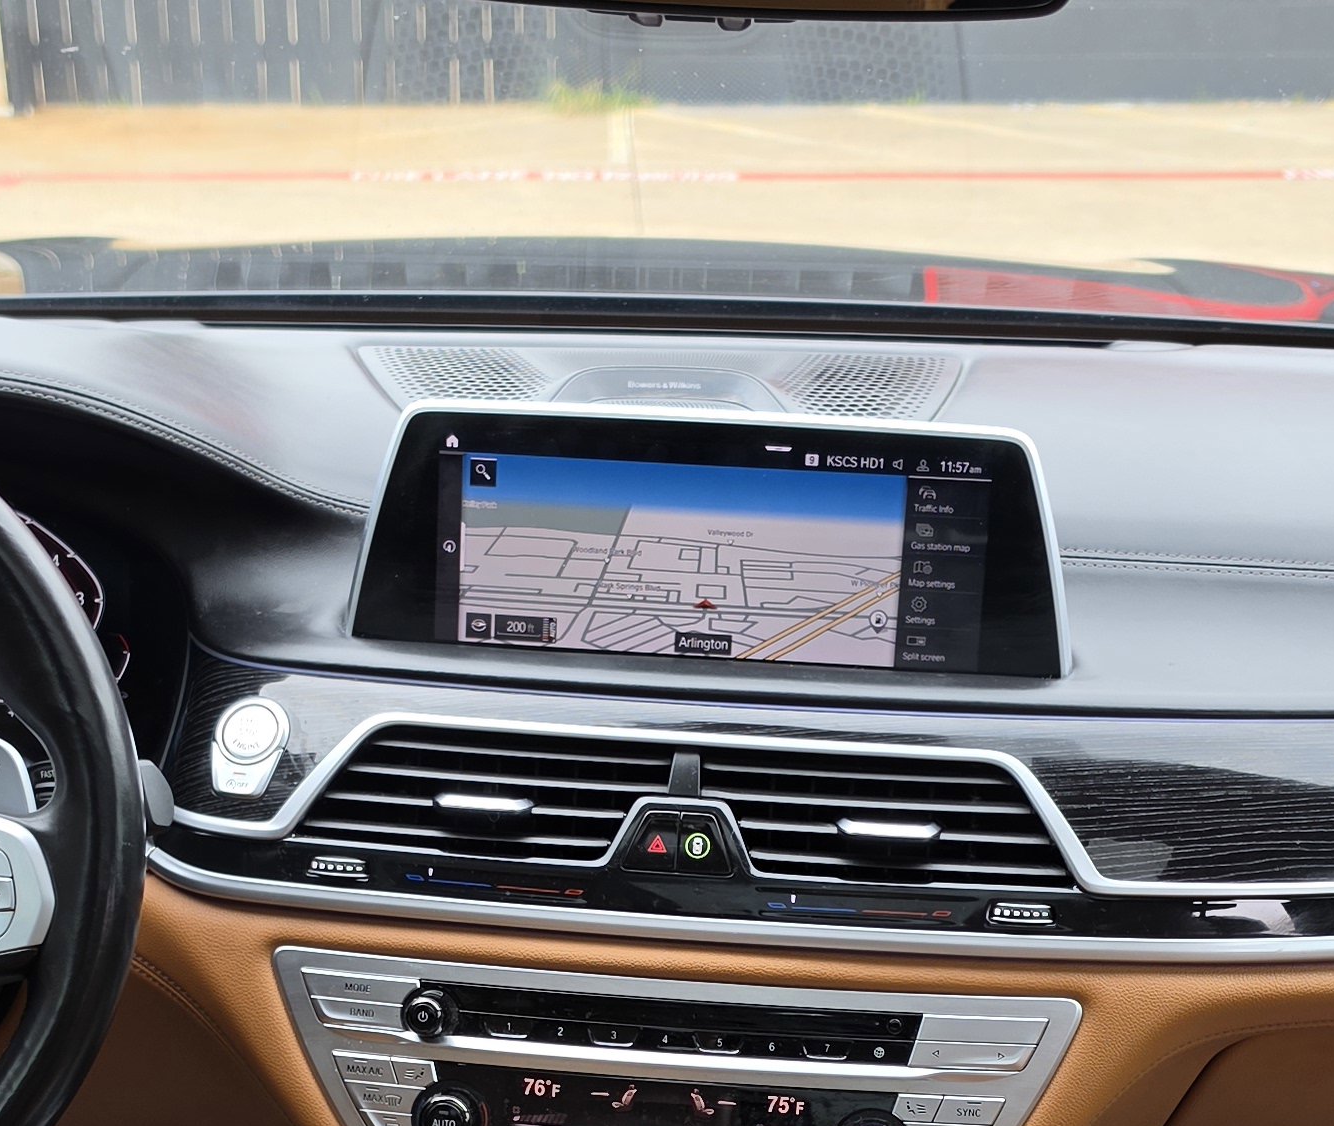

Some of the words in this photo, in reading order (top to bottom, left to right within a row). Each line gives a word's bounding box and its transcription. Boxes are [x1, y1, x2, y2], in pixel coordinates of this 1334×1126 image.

[826, 455, 858, 469] KSCS
[860, 457, 885, 470] HD1
[913, 503, 937, 513] Traffic
[938, 505, 955, 514] Info
[707, 529, 744, 538] Valleywood
[910, 541, 926, 551] Gas
[926, 541, 953, 552] station
[953, 544, 971, 553] map
[616, 583, 644, 592] Springs
[908, 578, 926, 588] Map
[926, 580, 956, 590] settings
[75, 591, 85, 606] 3
[905, 615, 936, 626] Settings
[506, 621, 527, 634] 200
[527, 622, 535, 633] ft
[678, 635, 729, 651] Arlington
[902, 652, 920, 661] Split
[920, 653, 946, 662] screen
[343, 982, 372, 994] MODE
[349, 1007, 375, 1018] BAND
[506, 1021, 511, 1032] 1
[557, 1026, 564, 1037] 2
[610, 1030, 617, 1041] 3
[661, 1034, 668, 1045] 4
[716, 1037, 723, 1048] 5
[768, 1042, 775, 1052] 6
[824, 1043, 830, 1054] 7
[346, 1064, 368, 1075] MAX
[368, 1066, 384, 1076] A/C
[523, 1077, 562, 1098] 76°F
[362, 1092, 384, 1103] MAX
[766, 1095, 805, 1116] 75°F
[956, 1107, 982, 1118] SYNC
